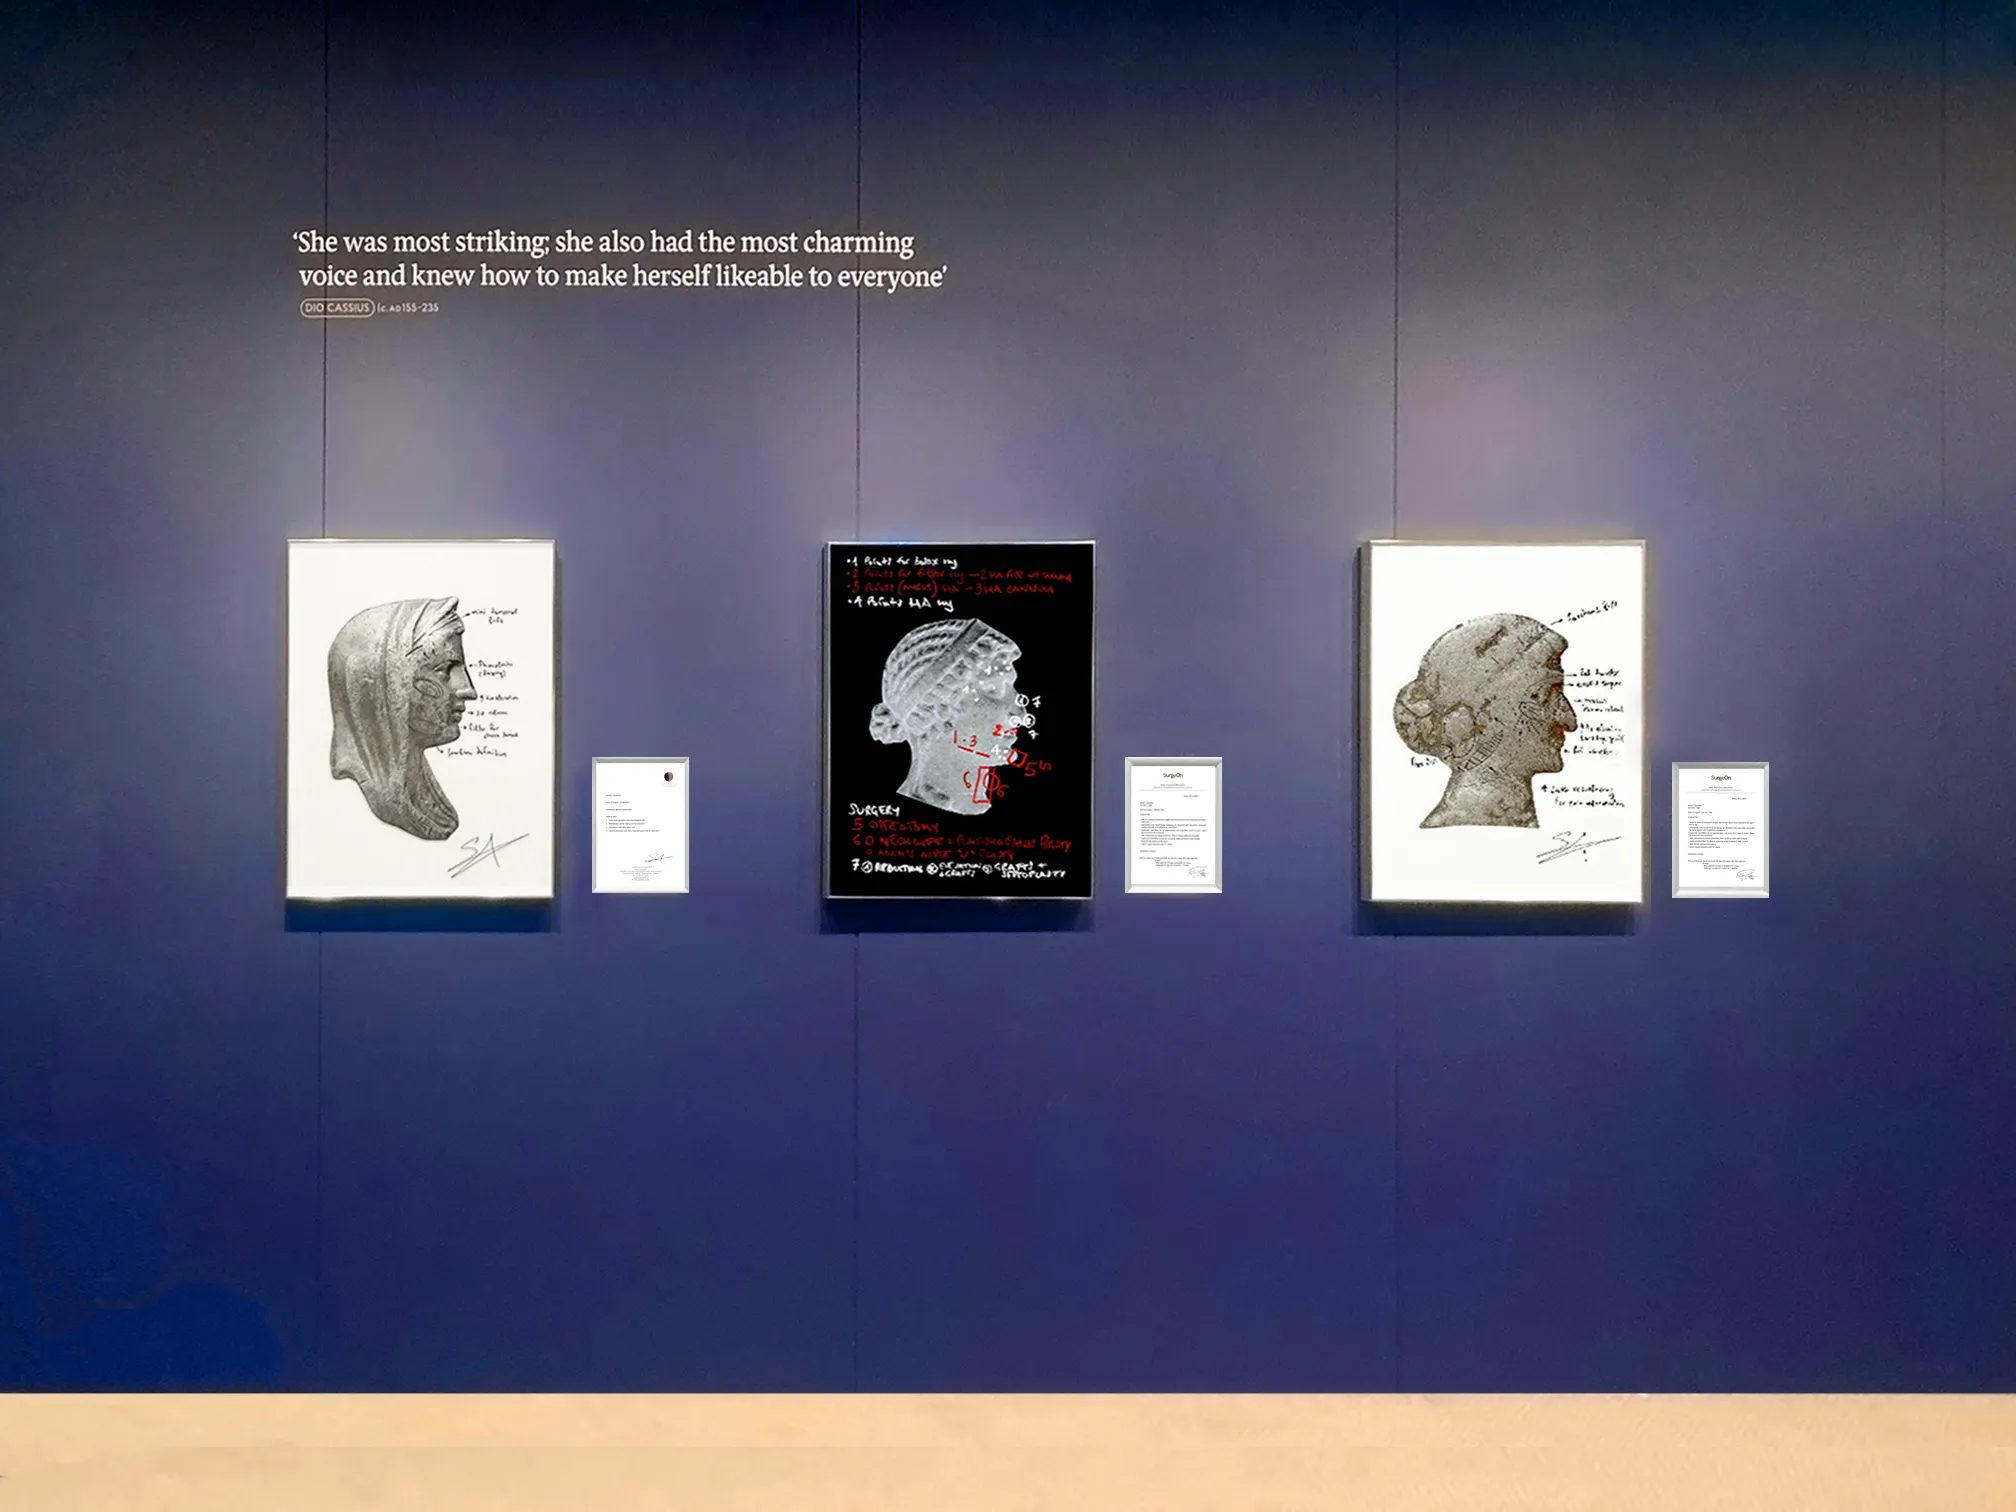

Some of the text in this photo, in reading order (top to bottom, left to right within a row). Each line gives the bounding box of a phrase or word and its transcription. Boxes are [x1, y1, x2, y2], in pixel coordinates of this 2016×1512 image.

[343, 236, 387, 252] was
[394, 233, 450, 252] most
[456, 229, 549, 258] striking;
[556, 230, 593, 252] she
[599, 230, 644, 252] also
[651, 230, 693, 252] had
[699, 230, 735, 252] the
[741, 233, 798, 252] most
[804, 230, 914, 259] charming
[299, 265, 357, 286] voice
[363, 264, 406, 286] and
[412, 263, 475, 285] knew
[481, 263, 531, 285] how
[536, 266, 559, 285] to
[565, 264, 627, 286] make
[633, 264, 712, 286] herself
[716, 264, 803, 286] likeable
[809, 267, 832, 286] to
[306, 303, 324, 312] DIO
[327, 303, 369, 312] CASSIUS
[968, 735, 978, 748] 3
